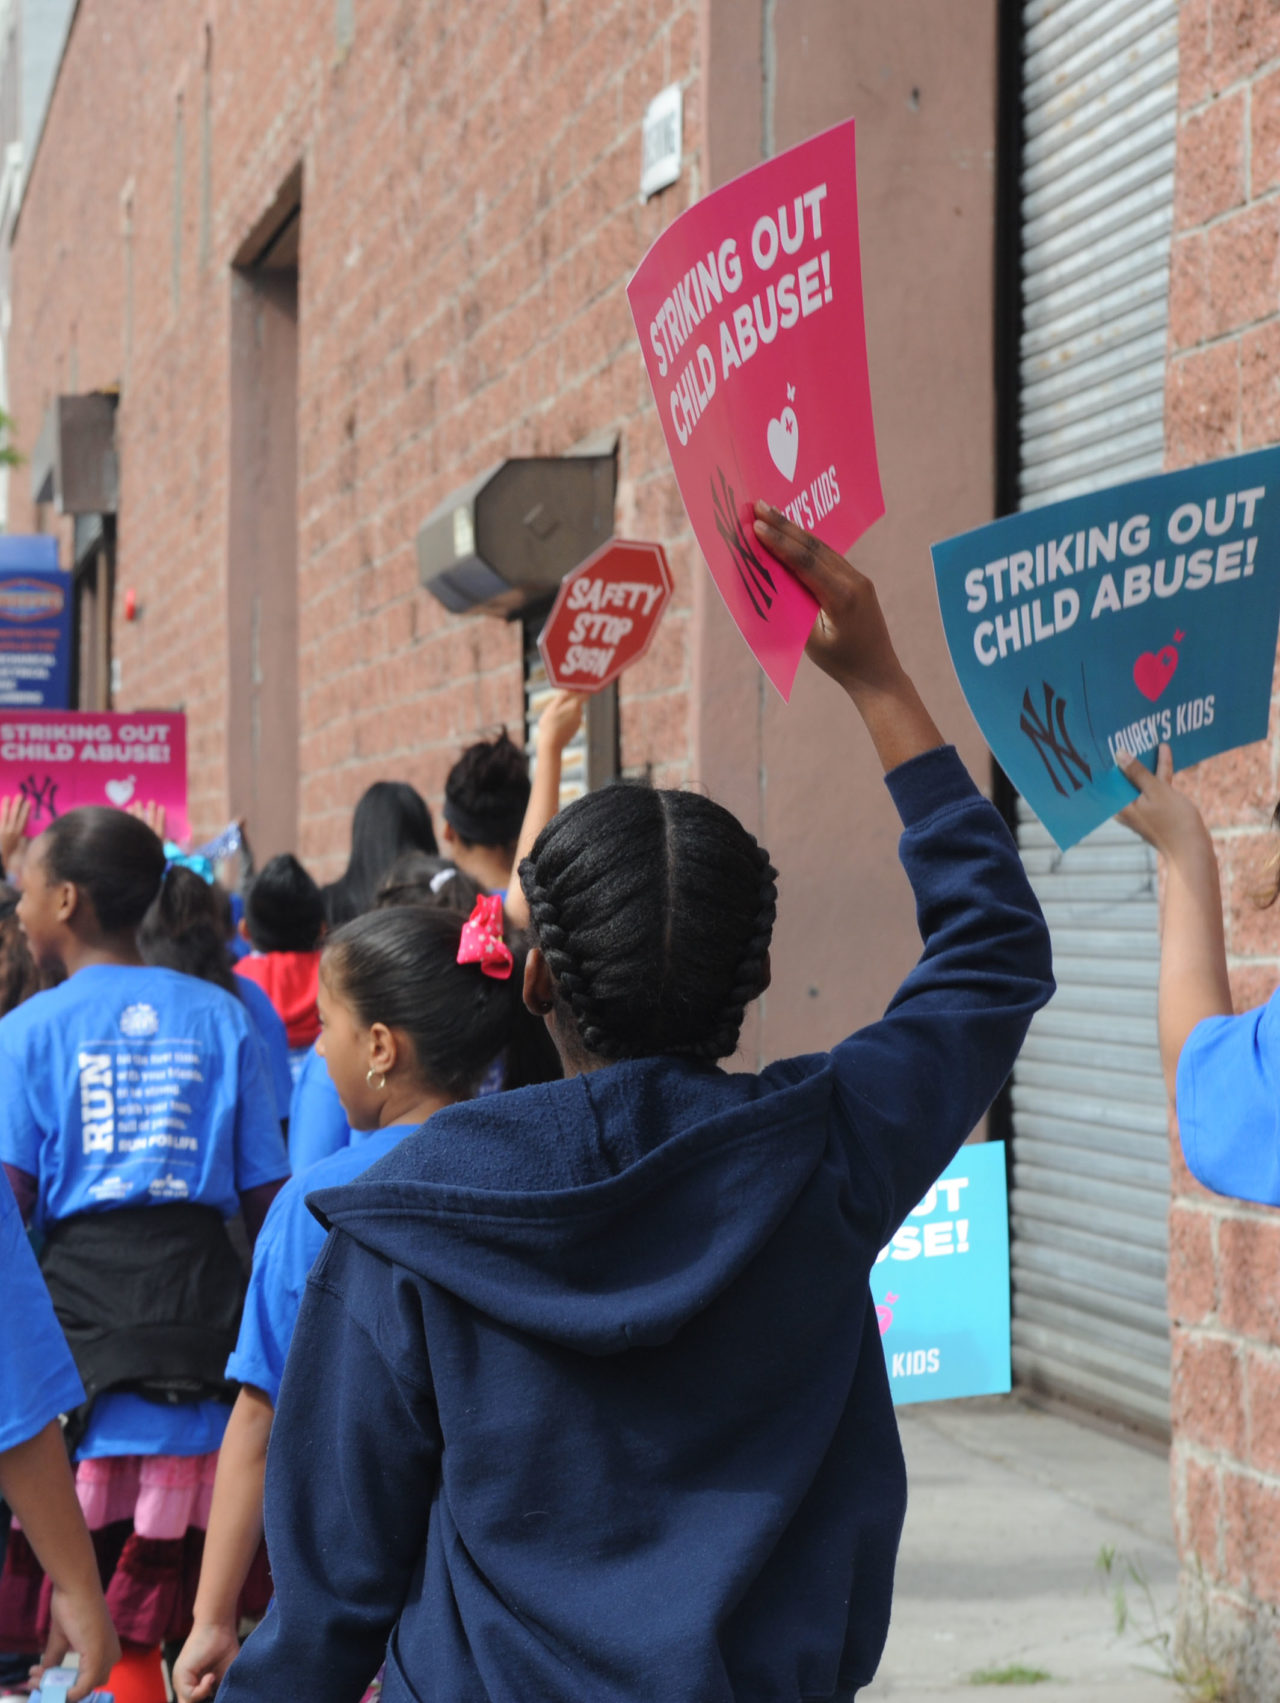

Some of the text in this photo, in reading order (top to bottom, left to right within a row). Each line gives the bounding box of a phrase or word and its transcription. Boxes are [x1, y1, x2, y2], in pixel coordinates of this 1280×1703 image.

[650, 183, 827, 377] STRIKING OUT
[669, 251, 834, 447] CHILD ABUSE!
[810, 464, 841, 522] KIDS
[964, 486, 1266, 614] STRIKING OUT
[567, 577, 663, 616] SAFETY
[973, 537, 1259, 667] CHILD ABUSE!
[568, 612, 633, 645] STOP
[560, 644, 615, 678] SIGN
[0, 723, 170, 743] STRIKING OUT
[1176, 695, 1215, 737] KIDS
[0, 743, 171, 763] CHILD ABUSE!
[78, 1052, 115, 1156] RUN
[909, 1176, 969, 1217] UT
[875, 1218, 969, 1264] SE!
[891, 1347, 941, 1378] KIDS
